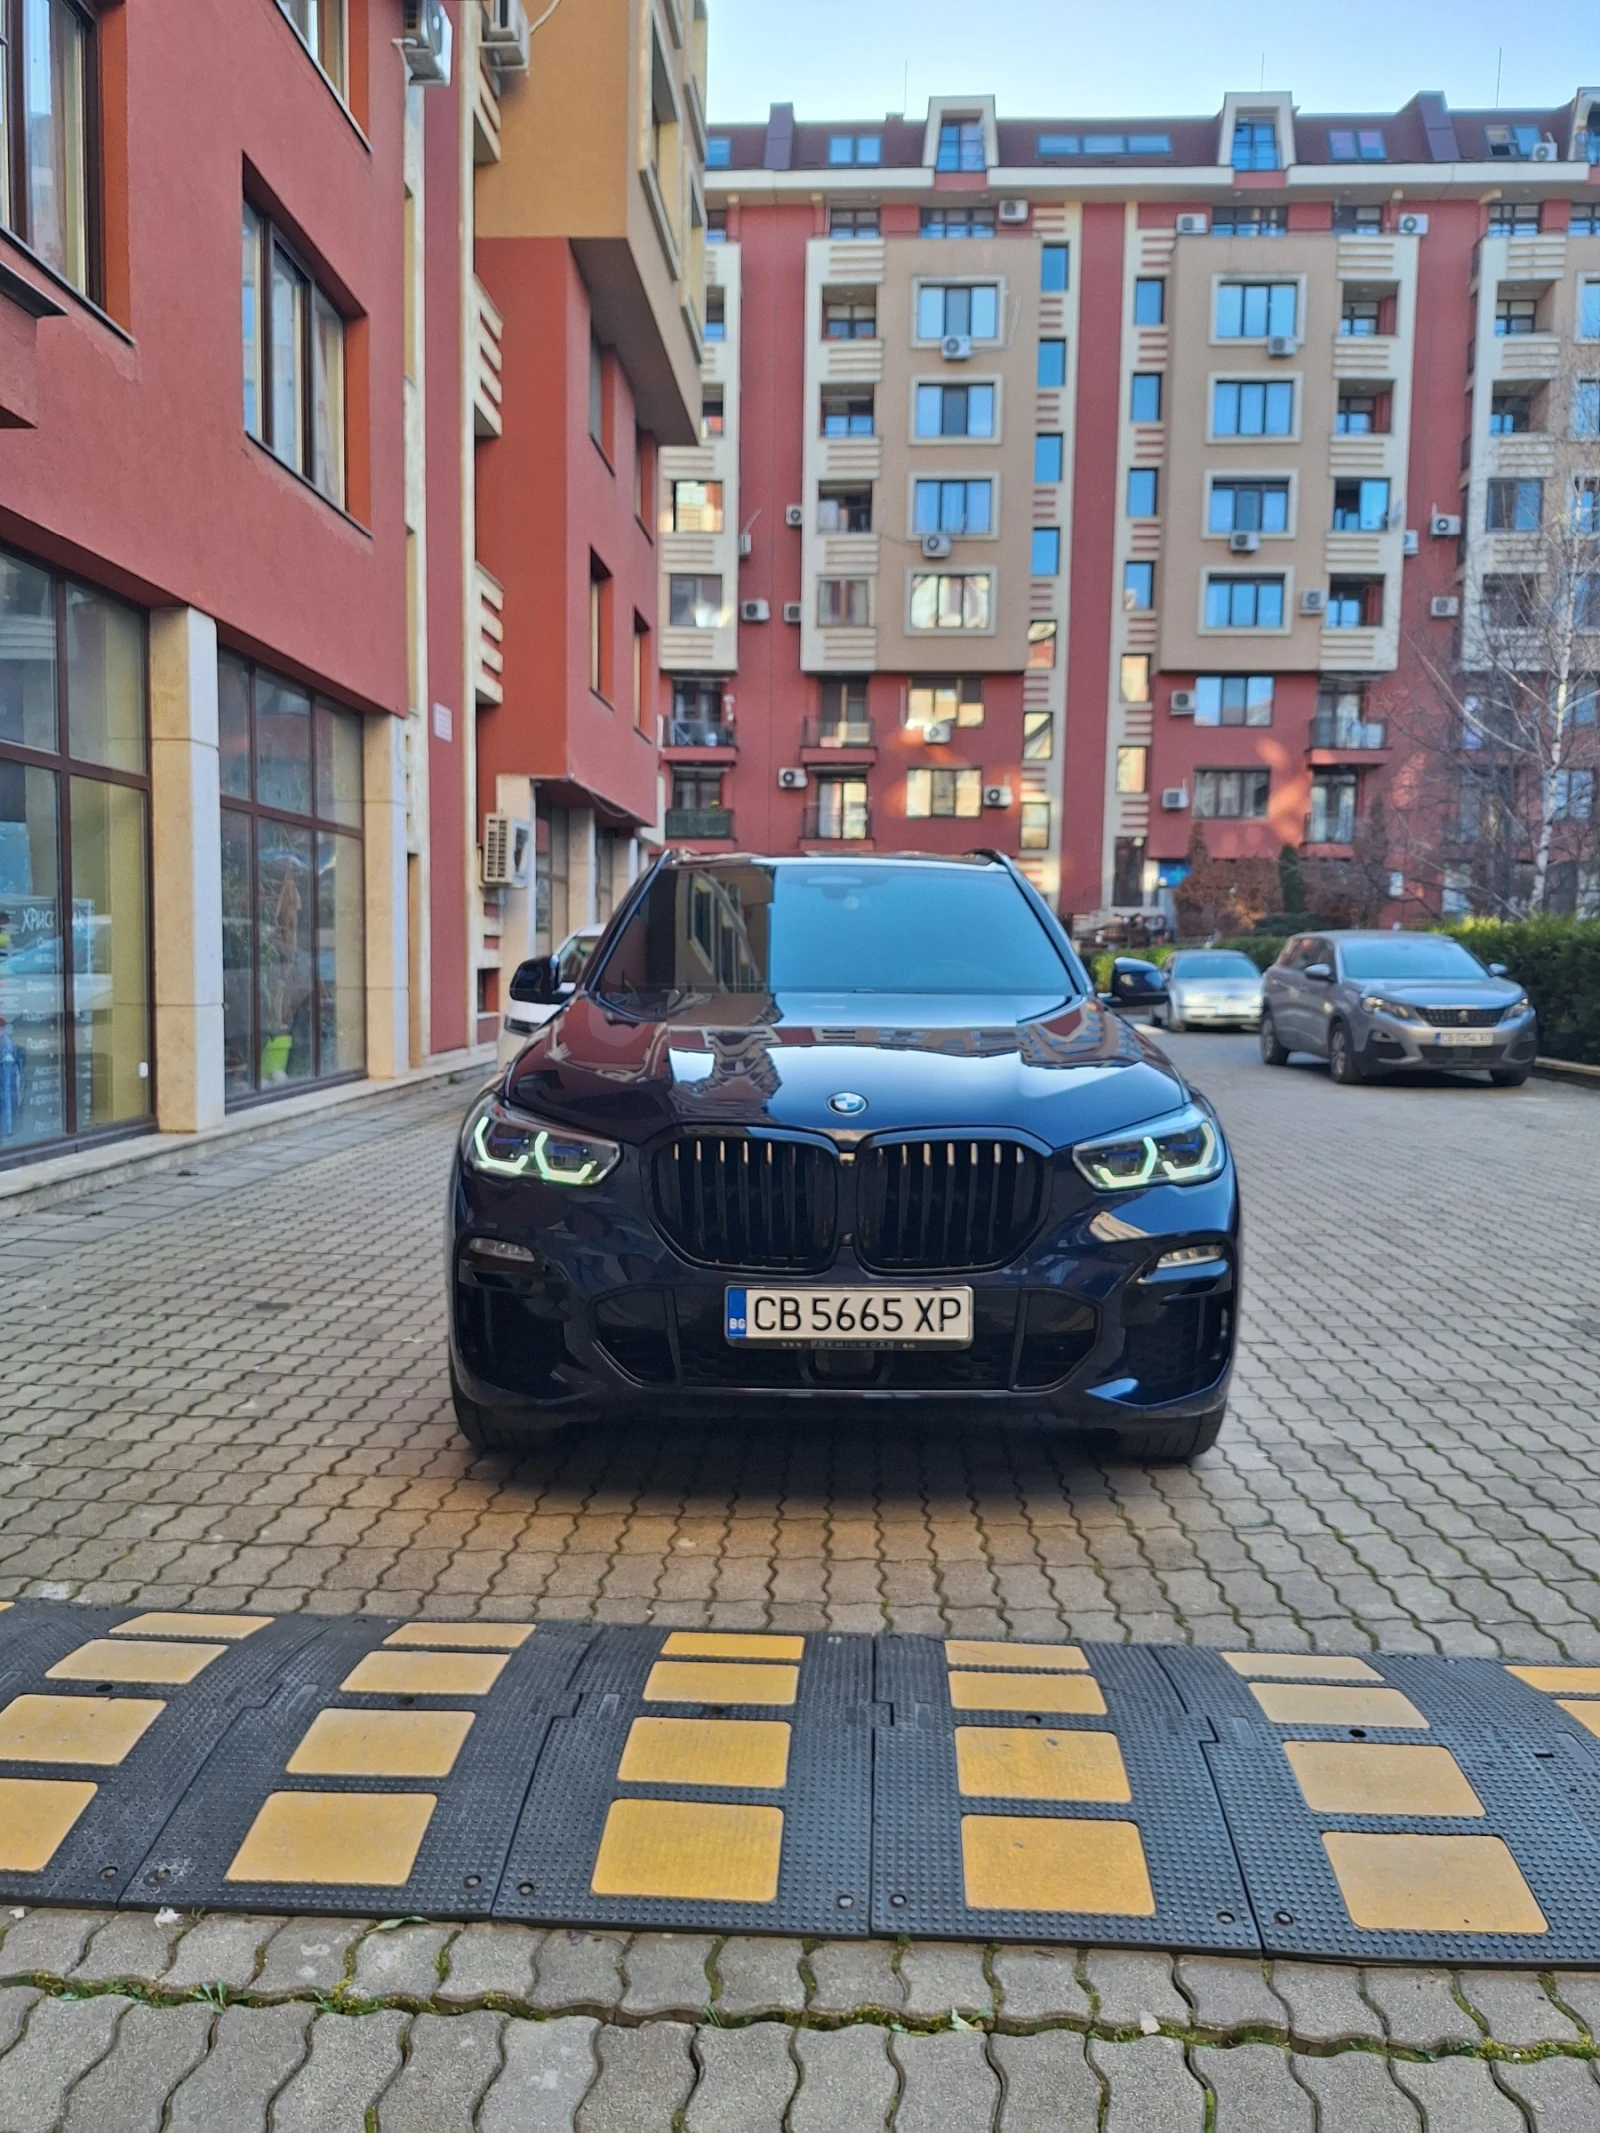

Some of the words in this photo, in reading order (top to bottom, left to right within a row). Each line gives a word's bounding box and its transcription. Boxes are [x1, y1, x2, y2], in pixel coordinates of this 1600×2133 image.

[729, 1317, 746, 1330] BG
[754, 1295, 802, 1332] CB
[811, 1296, 903, 1333] 5665
[914, 1297, 961, 1333] XP
